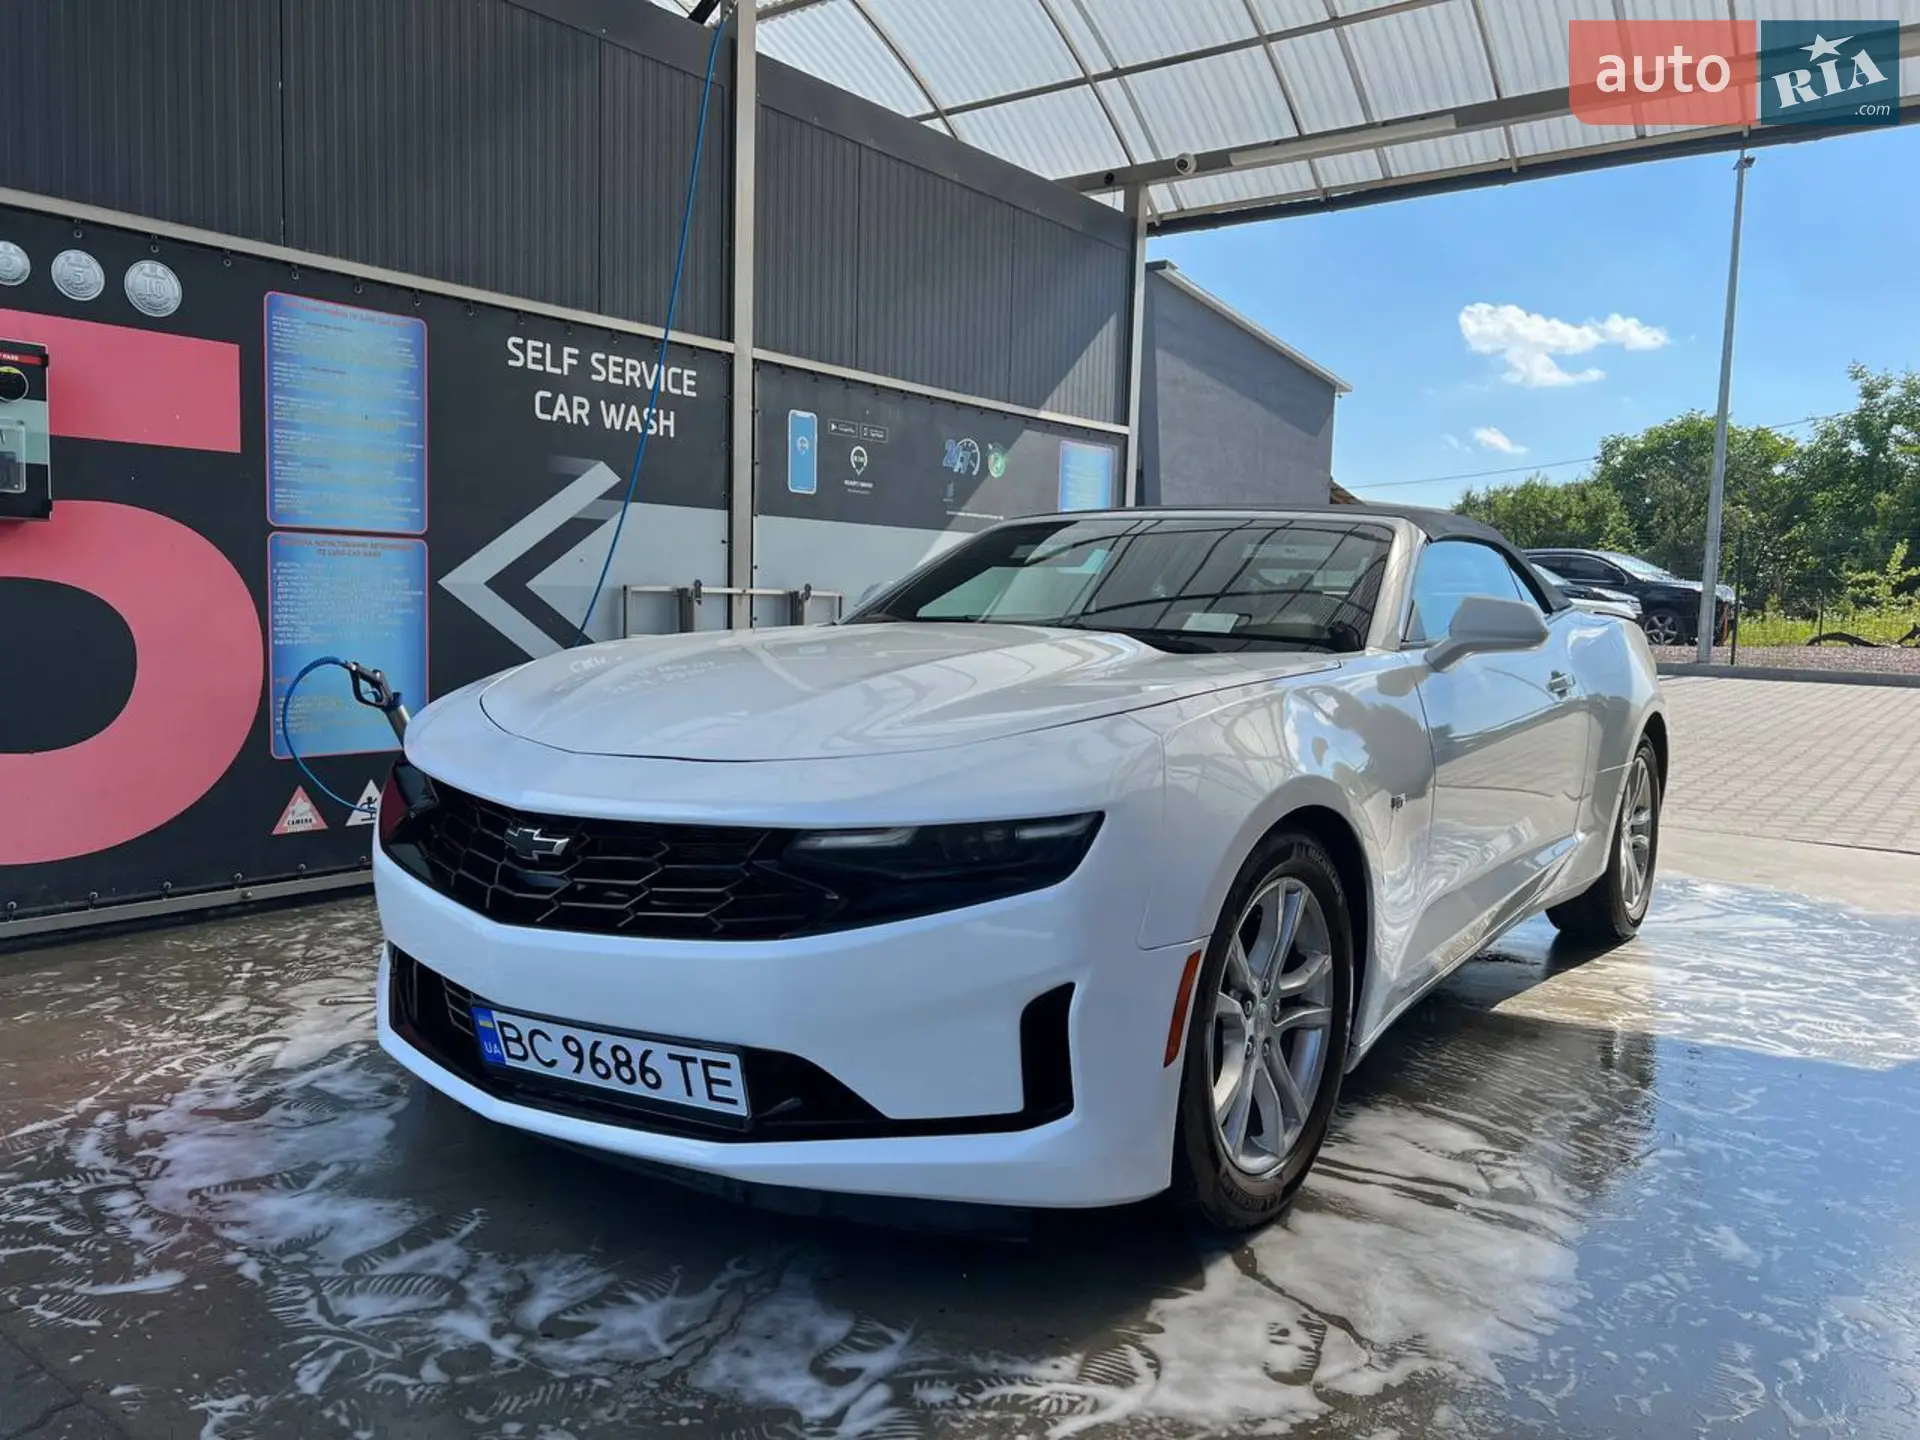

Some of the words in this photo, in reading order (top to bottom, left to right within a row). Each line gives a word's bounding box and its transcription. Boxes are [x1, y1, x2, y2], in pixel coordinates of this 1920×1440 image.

[507, 336, 579, 376] SELF
[590, 352, 697, 397] SERVICE
[534, 390, 590, 426] CAR
[600, 400, 675, 438] WASH
[484, 1040, 502, 1056] UA
[497, 1020, 557, 1068] BC
[562, 1035, 662, 1090] 9686
[667, 1052, 738, 1105] TE
